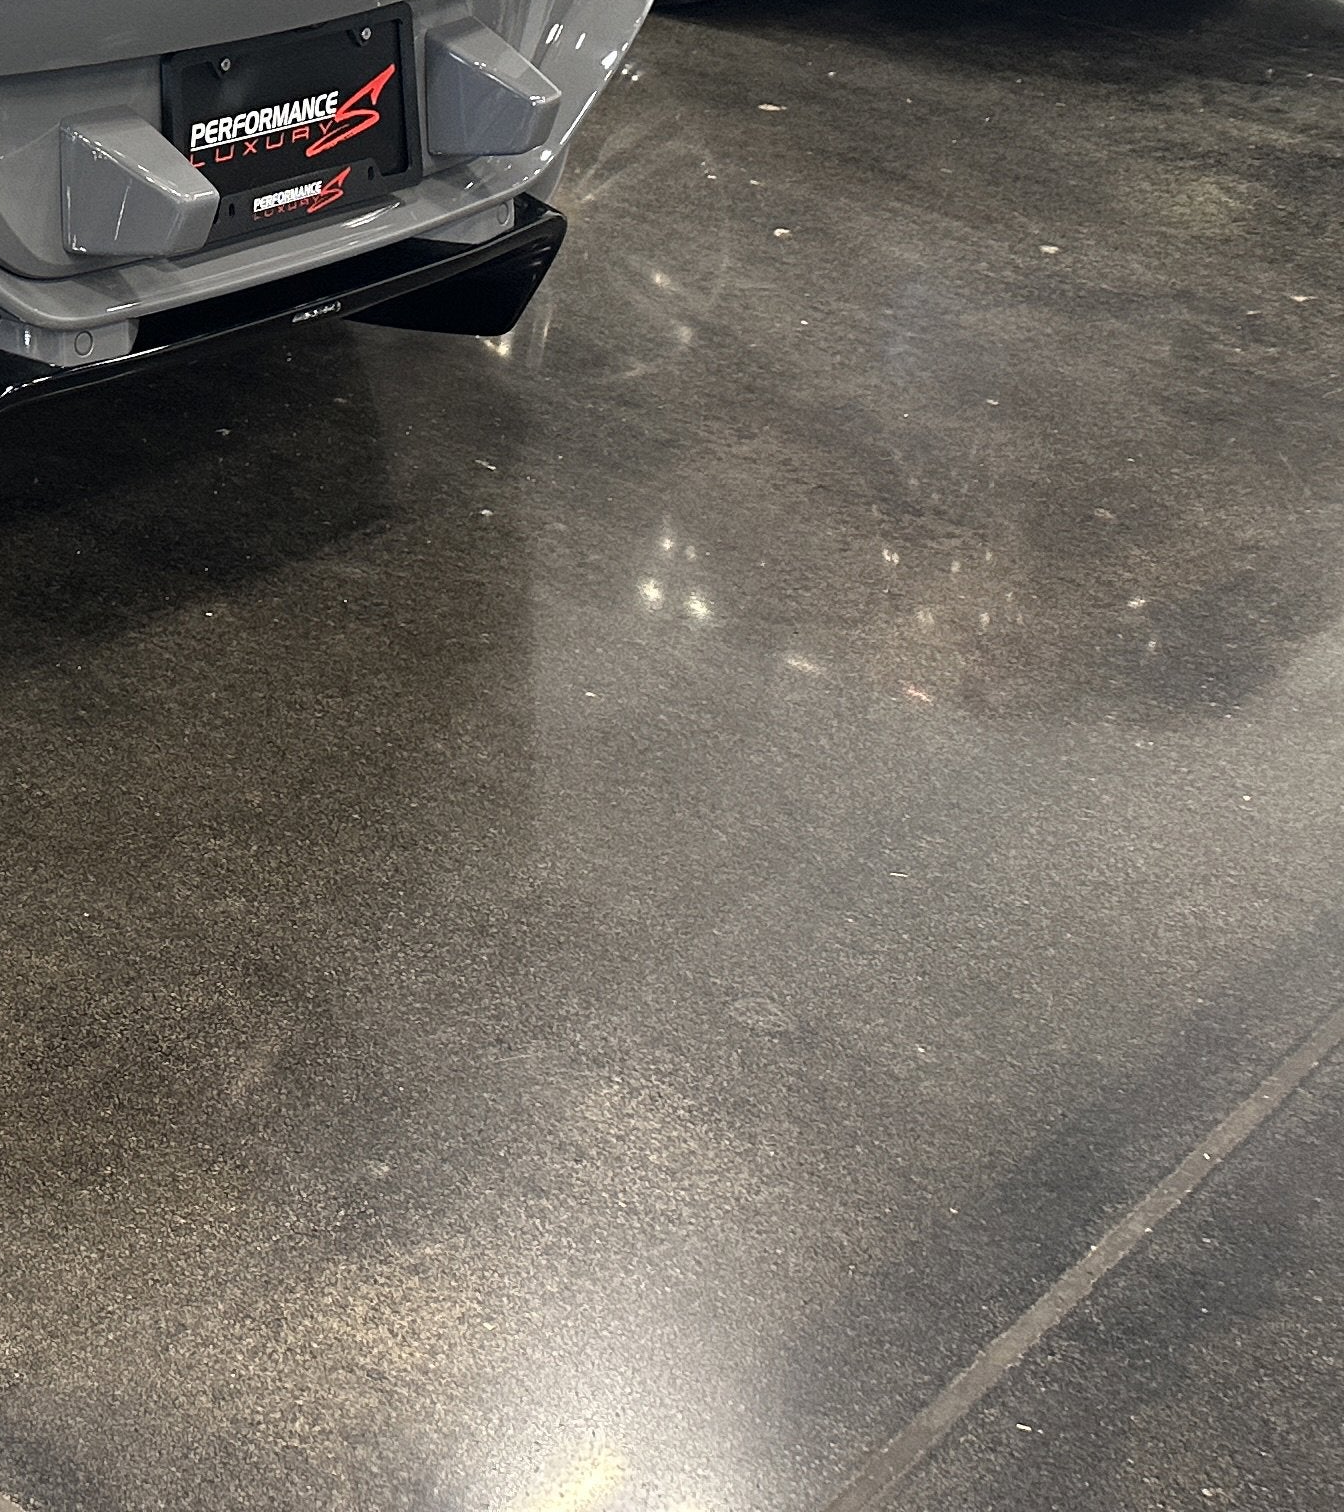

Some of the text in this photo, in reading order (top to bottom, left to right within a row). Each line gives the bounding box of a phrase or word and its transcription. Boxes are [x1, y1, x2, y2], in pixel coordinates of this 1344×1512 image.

[189, 120, 333, 168] LUXURY
[190, 90, 340, 150] PERFORMANCE
[253, 180, 323, 213] PERFORMANCE
